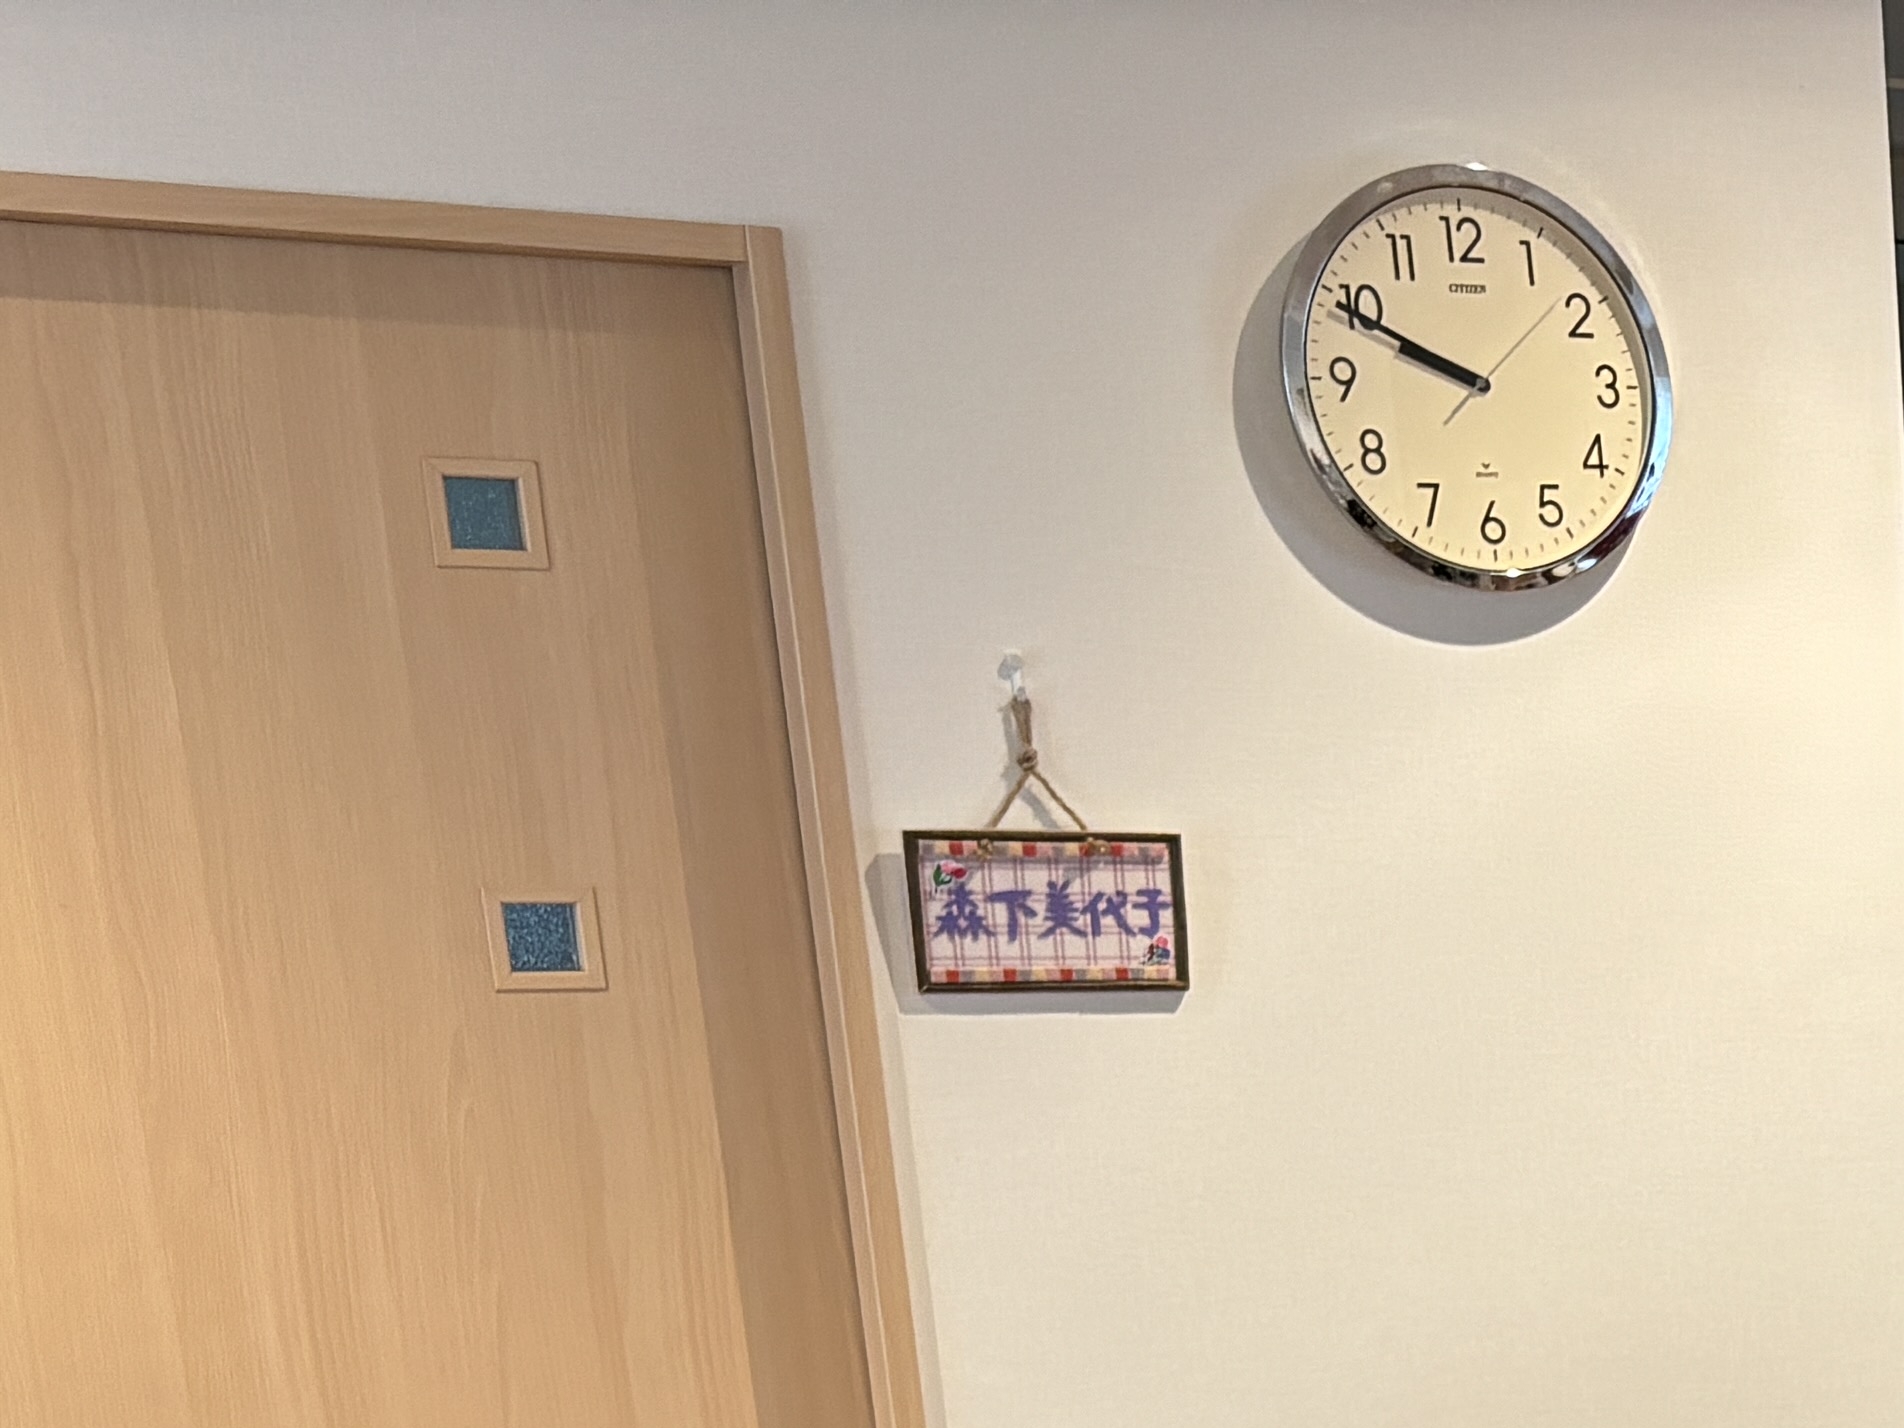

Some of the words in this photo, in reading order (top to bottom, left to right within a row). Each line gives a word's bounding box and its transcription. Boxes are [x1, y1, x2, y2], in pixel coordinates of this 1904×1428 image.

[1385, 234, 1417, 282] 11
[1439, 216, 1486, 264] 12
[1519, 240, 1536, 287] 1
[1339, 284, 1384, 330] 10
[1565, 292, 1595, 339] 2
[1329, 357, 1358, 402] 9
[1595, 364, 1620, 409] 3
[1359, 428, 1387, 475] 8
[1582, 433, 1610, 478] 4
[1416, 483, 1441, 527] 7
[1480, 500, 1507, 545] 6
[1537, 484, 1564, 527] 5
